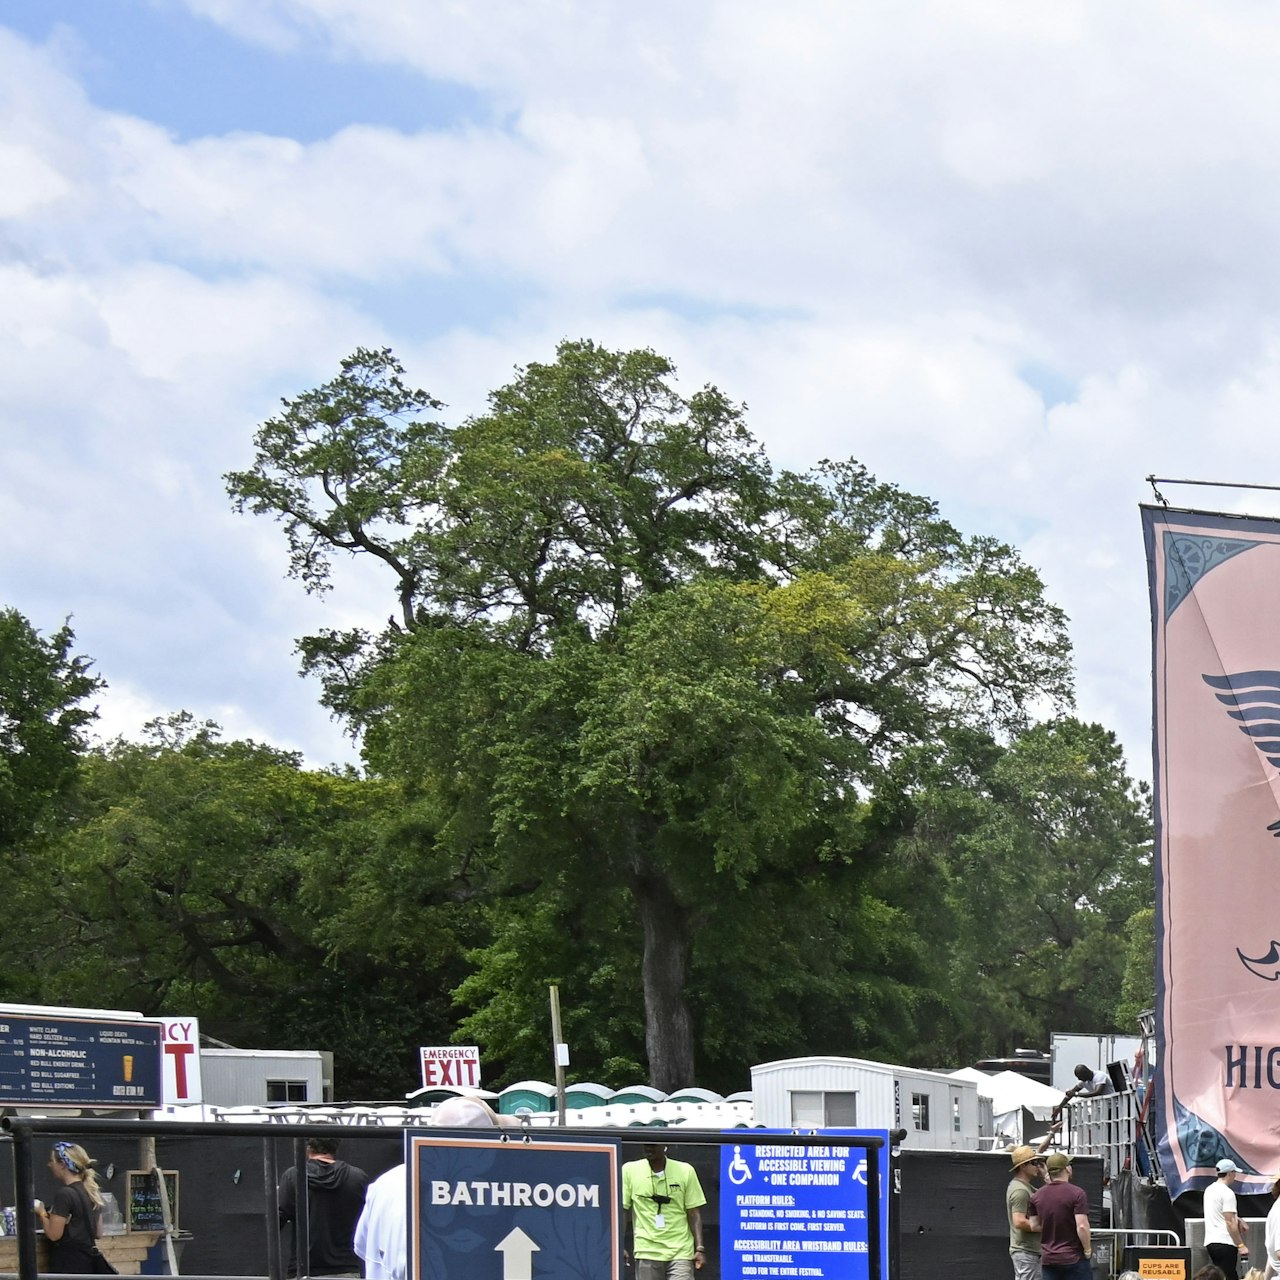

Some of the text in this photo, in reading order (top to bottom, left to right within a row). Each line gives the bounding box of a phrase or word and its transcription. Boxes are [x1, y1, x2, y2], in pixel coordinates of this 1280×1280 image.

[30, 1048, 87, 1058] NON-ALCOHOLIC
[423, 1049, 476, 1059] EMERGENCY
[425, 1059, 477, 1087] EXIT
[755, 1145, 850, 1158] RESTRICTED AREA FOR
[758, 1159, 846, 1172] ACCESSIBLE VIEWING
[770, 1173, 788, 1186] ONE
[789, 1173, 840, 1186] COMPANION
[431, 1180, 600, 1208] BATHROOM
[736, 1195, 795, 1206] PLATFORM RULES:
[740, 1209, 748, 1217] NO
[776, 1210, 784, 1218] NO
[811, 1210, 817, 1218] &
[817, 1210, 826, 1218] NO
[847, 1211, 866, 1219] SEATS.
[740, 1222, 846, 1232] PLATFORM IS FIRST COME, FIRST SERVED.
[734, 1240, 868, 1251] ACCESSIBILITY AREA WRISTBAND RULES:
[742, 1254, 753, 1262] NON
[742, 1266, 824, 1276] GOOD FOR THE ENTIRE FESTIVAL.
